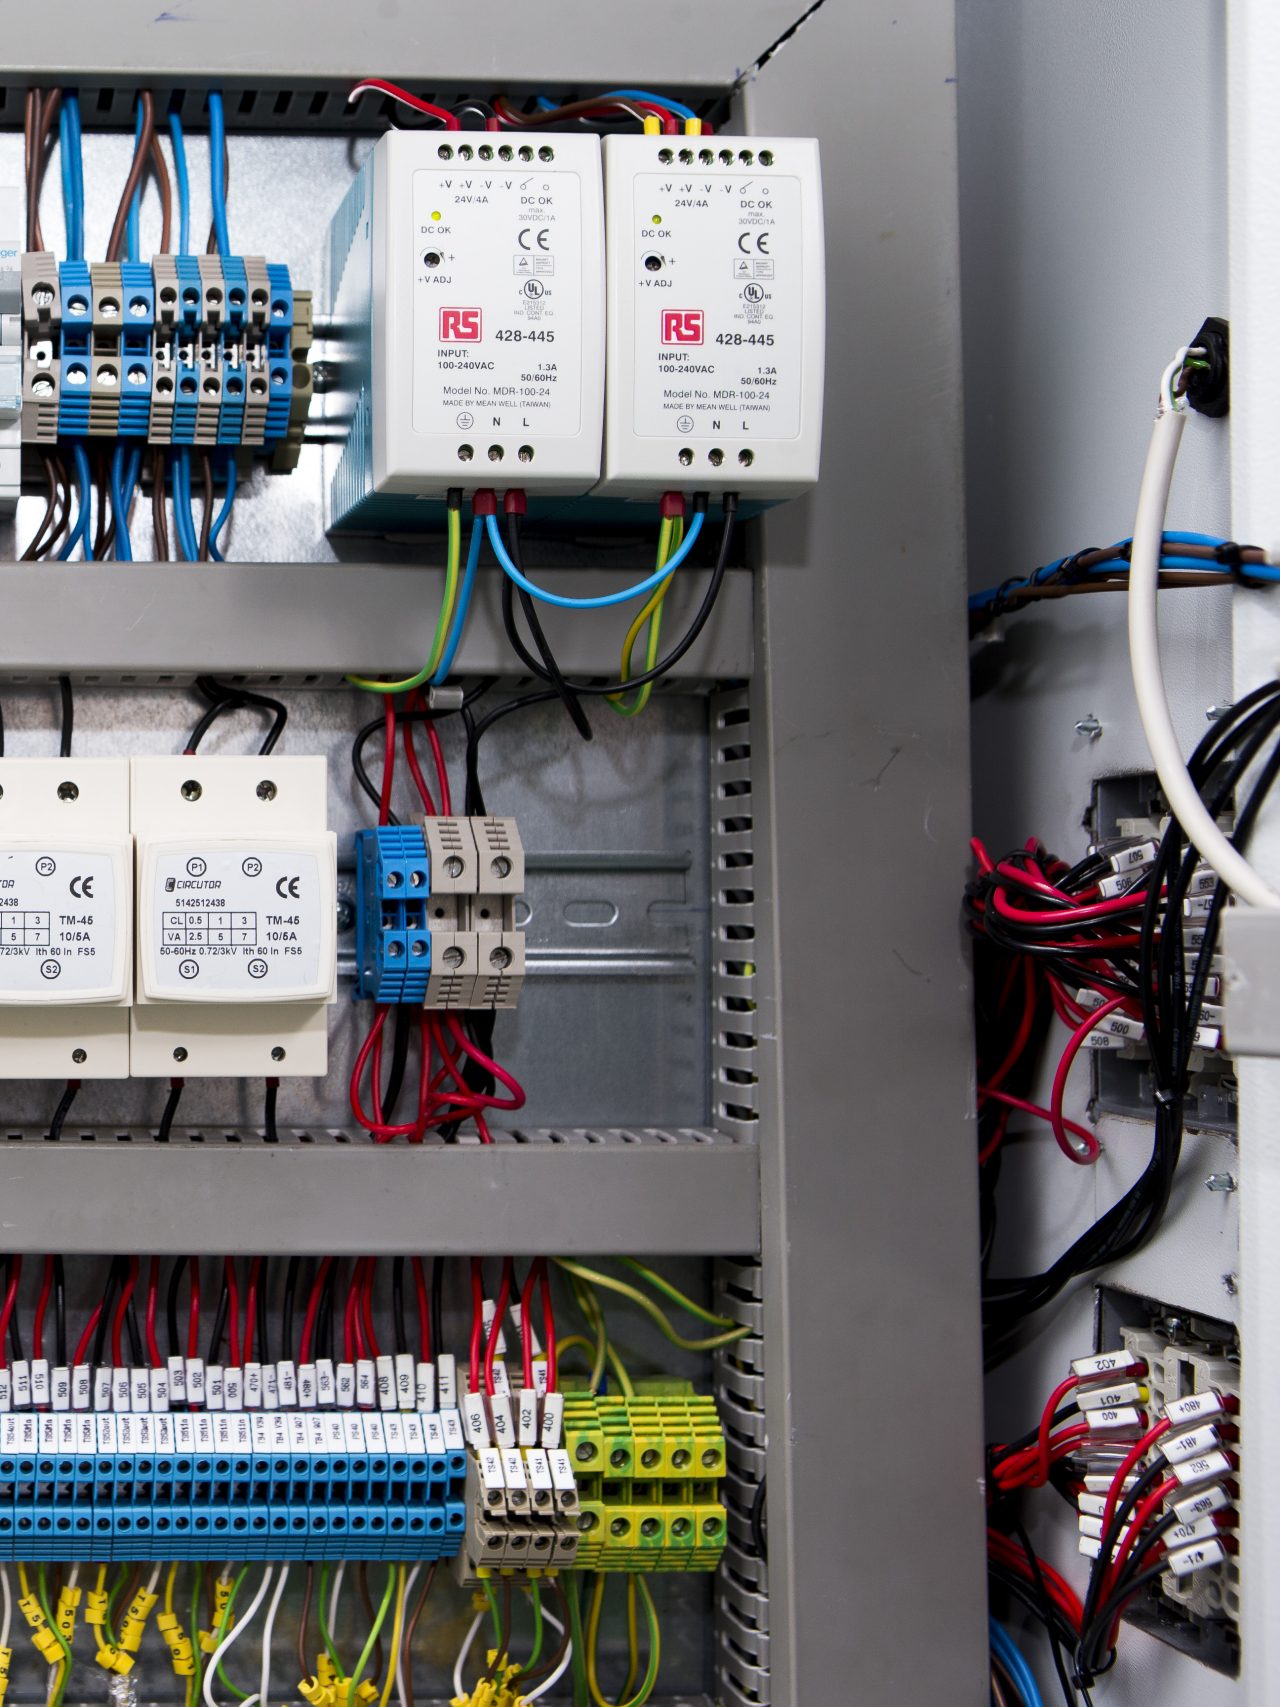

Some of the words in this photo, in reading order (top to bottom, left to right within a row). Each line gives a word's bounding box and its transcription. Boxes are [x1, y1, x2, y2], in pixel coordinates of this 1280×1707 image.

[454, 196, 488, 204] 24V/4A
[521, 197, 535, 205] DC
[538, 197, 552, 205] OK
[642, 230, 655, 238] DC
[443, 311, 478, 339] RS
[665, 313, 700, 341] RS
[496, 330, 554, 342] 428-445
[716, 334, 774, 346] 428-445
[658, 353, 689, 361] INPUT:
[438, 362, 494, 370] 100-240VAC
[659, 365, 714, 373] 100-240VAC
[521, 374, 557, 382] 50/60Hz
[443, 387, 471, 395] Model
[475, 387, 490, 395] No.
[493, 387, 550, 396] MDR-100-24
[664, 390, 691, 398] Model
[695, 391, 710, 399] No.
[713, 391, 769, 399] MDR-100-24
[740, 404, 770, 412] (TAIWAN)
[41, 863, 52, 871] P2
[177, 880, 221, 889] CIRCUTOR
[176, 899, 225, 907] 5142512438
[59, 916, 93, 925] TM-45
[266, 916, 300, 925] TM-45
[60, 932, 90, 941] 10/5A
[267, 932, 297, 940] 10/5A
[160, 947, 196, 955] 50-60Hz
[199, 947, 237, 955] 0.72/3kV
[1110, 1023, 1129, 1035] 500
[1091, 1036, 1109, 1046] 508
[1097, 1358, 1116, 1371] 402
[380, 1376, 389, 1395] 408
[399, 1374, 409, 1393] 409
[473, 1414, 482, 1433] 406
[522, 1409, 531, 1429] 402
[544, 1413, 554, 1432] 400
[497, 1415, 506, 1434] 404
[488, 1456, 496, 1473] TS42
